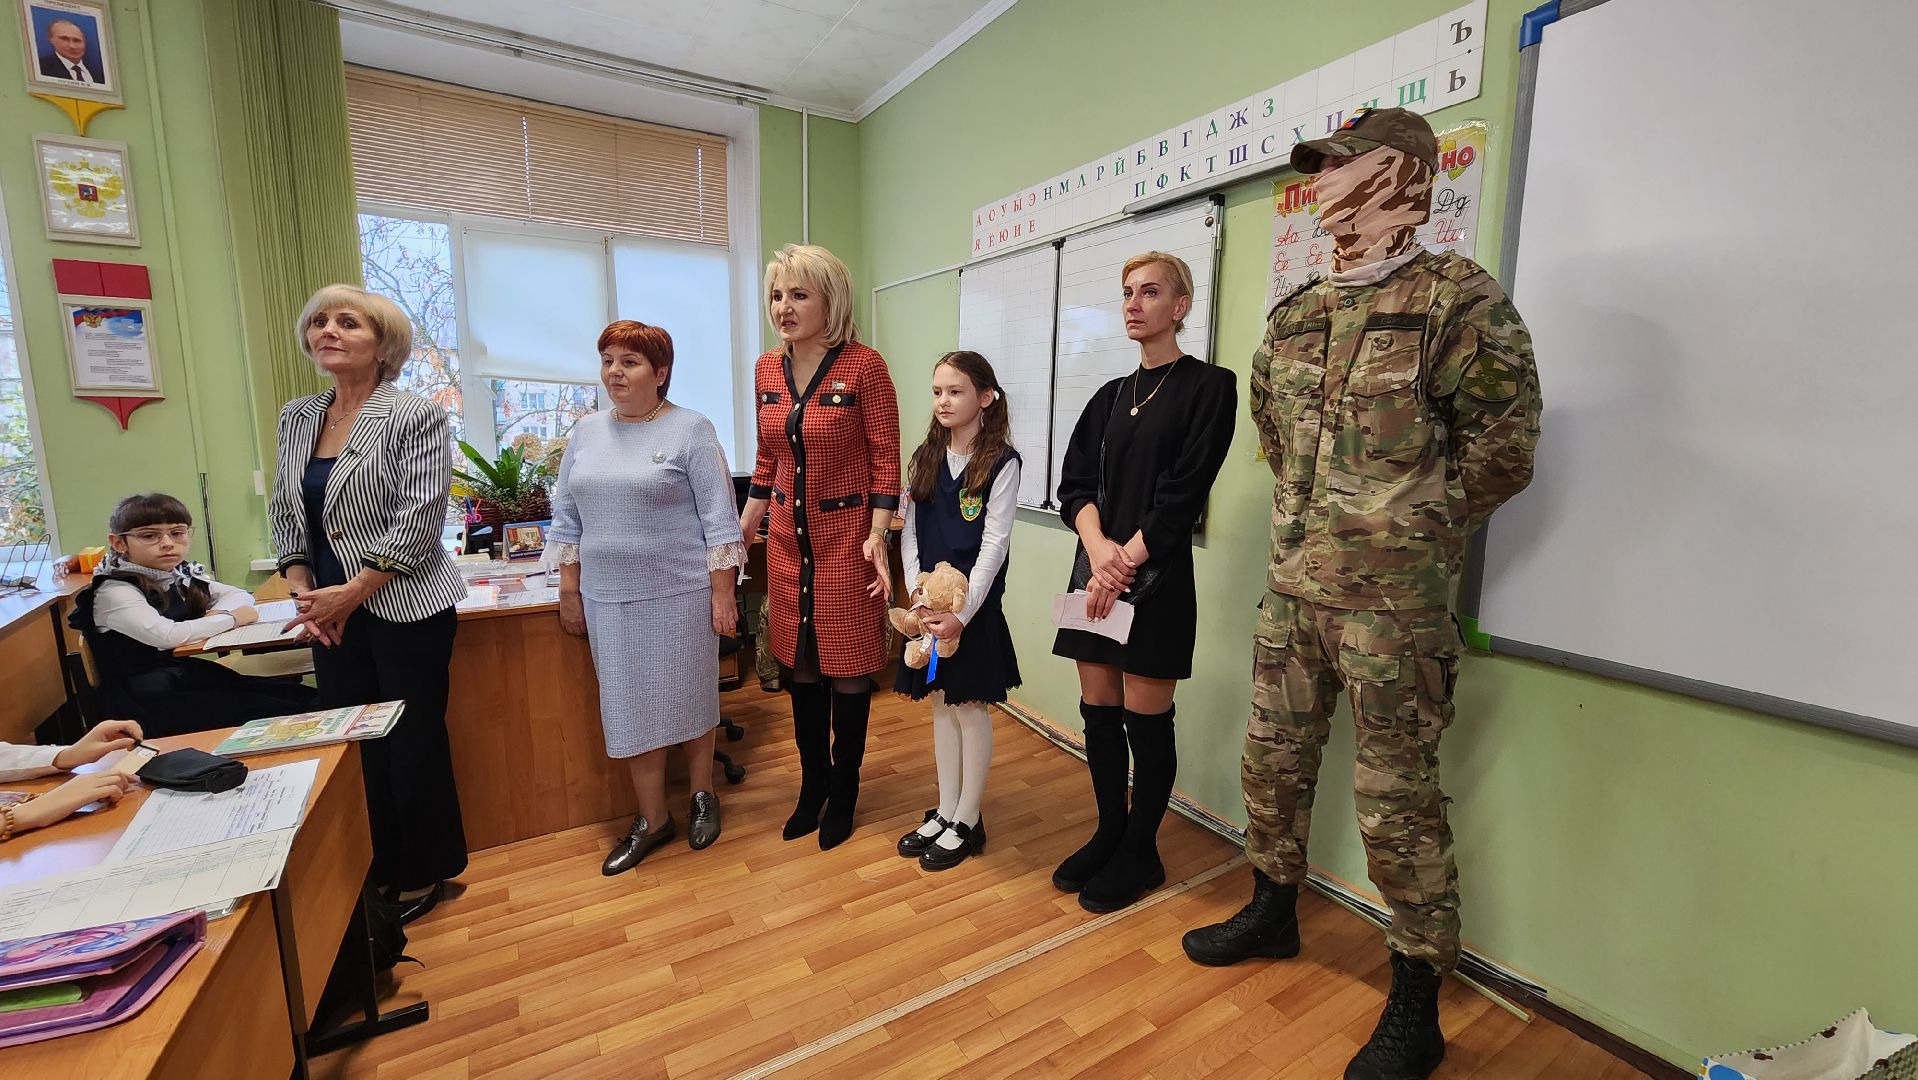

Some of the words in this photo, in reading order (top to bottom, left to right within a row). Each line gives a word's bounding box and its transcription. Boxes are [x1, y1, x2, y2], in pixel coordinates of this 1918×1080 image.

[974, 239, 981, 251] Я
[999, 231, 1008, 243] Ю
[1014, 224, 1021, 238] И
[1029, 220, 1036, 233] Е
[1134, 180, 1146, 198] П
[1156, 173, 1168, 189] Ф
[1180, 163, 1192, 182] К
[1205, 155, 1218, 174] Т
[1228, 144, 1248, 166] Ш
[1260, 135, 1275, 155] С
[1397, 77, 1428, 107] Щ
[1447, 69, 1467, 93] Ь
[976, 215, 982, 227] А
[988, 209, 995, 221] О
[1000, 203, 1008, 216] У
[1028, 193, 1036, 207] Э
[1044, 186, 1052, 200] Н
[1059, 180, 1069, 195] М
[1097, 165, 1105, 180] Р
[1114, 157, 1125, 176] Й
[1136, 149, 1146, 166] Б
[1158, 140, 1169, 157] В
[1182, 130, 1192, 148] Г
[1206, 118, 1218, 140] Д
[1229, 107, 1249, 131] Ж
[1450, 19, 1472, 45] Ъ
